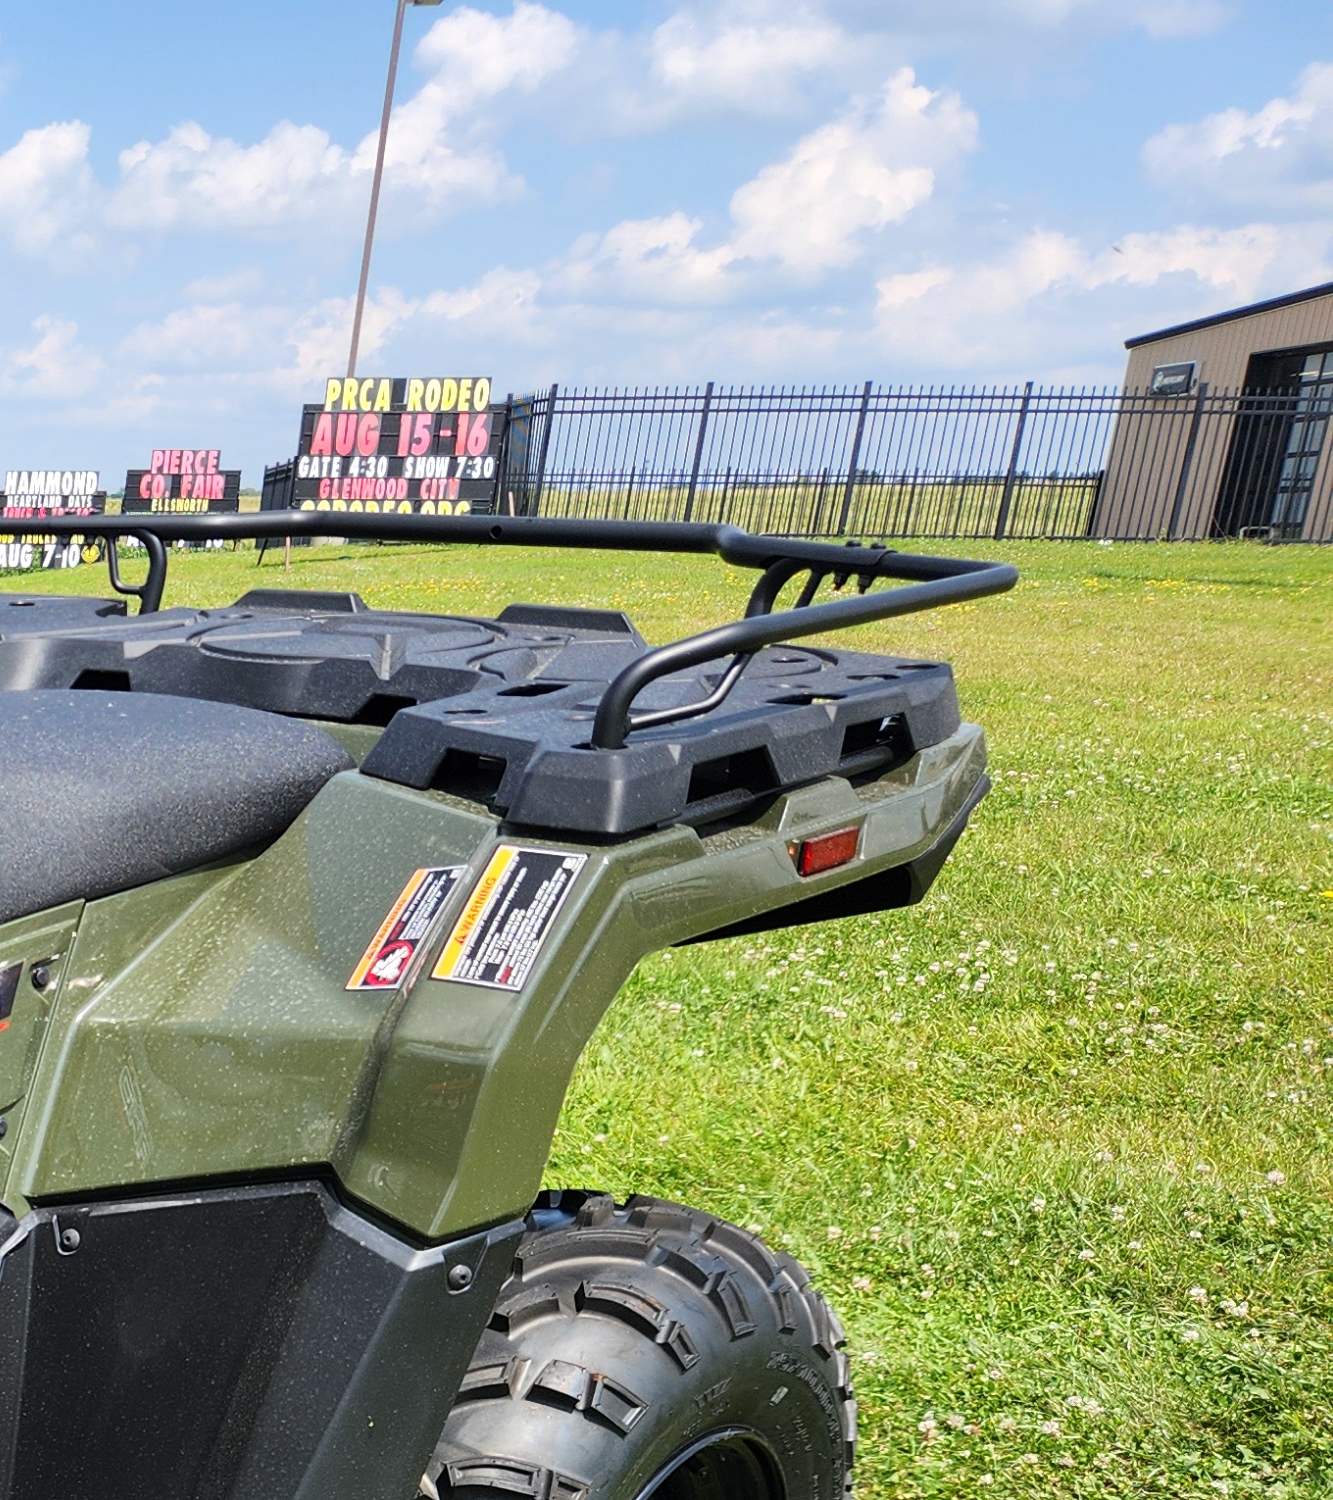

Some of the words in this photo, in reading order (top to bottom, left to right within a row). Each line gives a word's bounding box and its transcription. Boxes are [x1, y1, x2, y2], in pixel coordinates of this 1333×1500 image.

[324, 378, 391, 412] PRCA
[407, 378, 490, 412] RODEO
[310, 413, 380, 456] AUG
[397, 413, 488, 456] 15-16
[151, 450, 219, 474] PIERCE
[298, 456, 341, 478] GATE
[349, 456, 388, 477] 4:30
[404, 456, 450, 477] SHOW
[455, 456, 494, 477] 7:30
[4, 471, 98, 495] HAMMOND
[139, 474, 170, 499] CO.
[180, 474, 224, 499] FAIR
[319, 478, 408, 499] GLENWOOD
[420, 478, 460, 499] CITY
[6, 495, 62, 508] HEARTLAND
[68, 495, 93, 508] DAYS
[151, 498, 209, 512] ELLSWORTH
[42, 544, 80, 568] 7-10
[461, 876, 497, 933] WARNING
